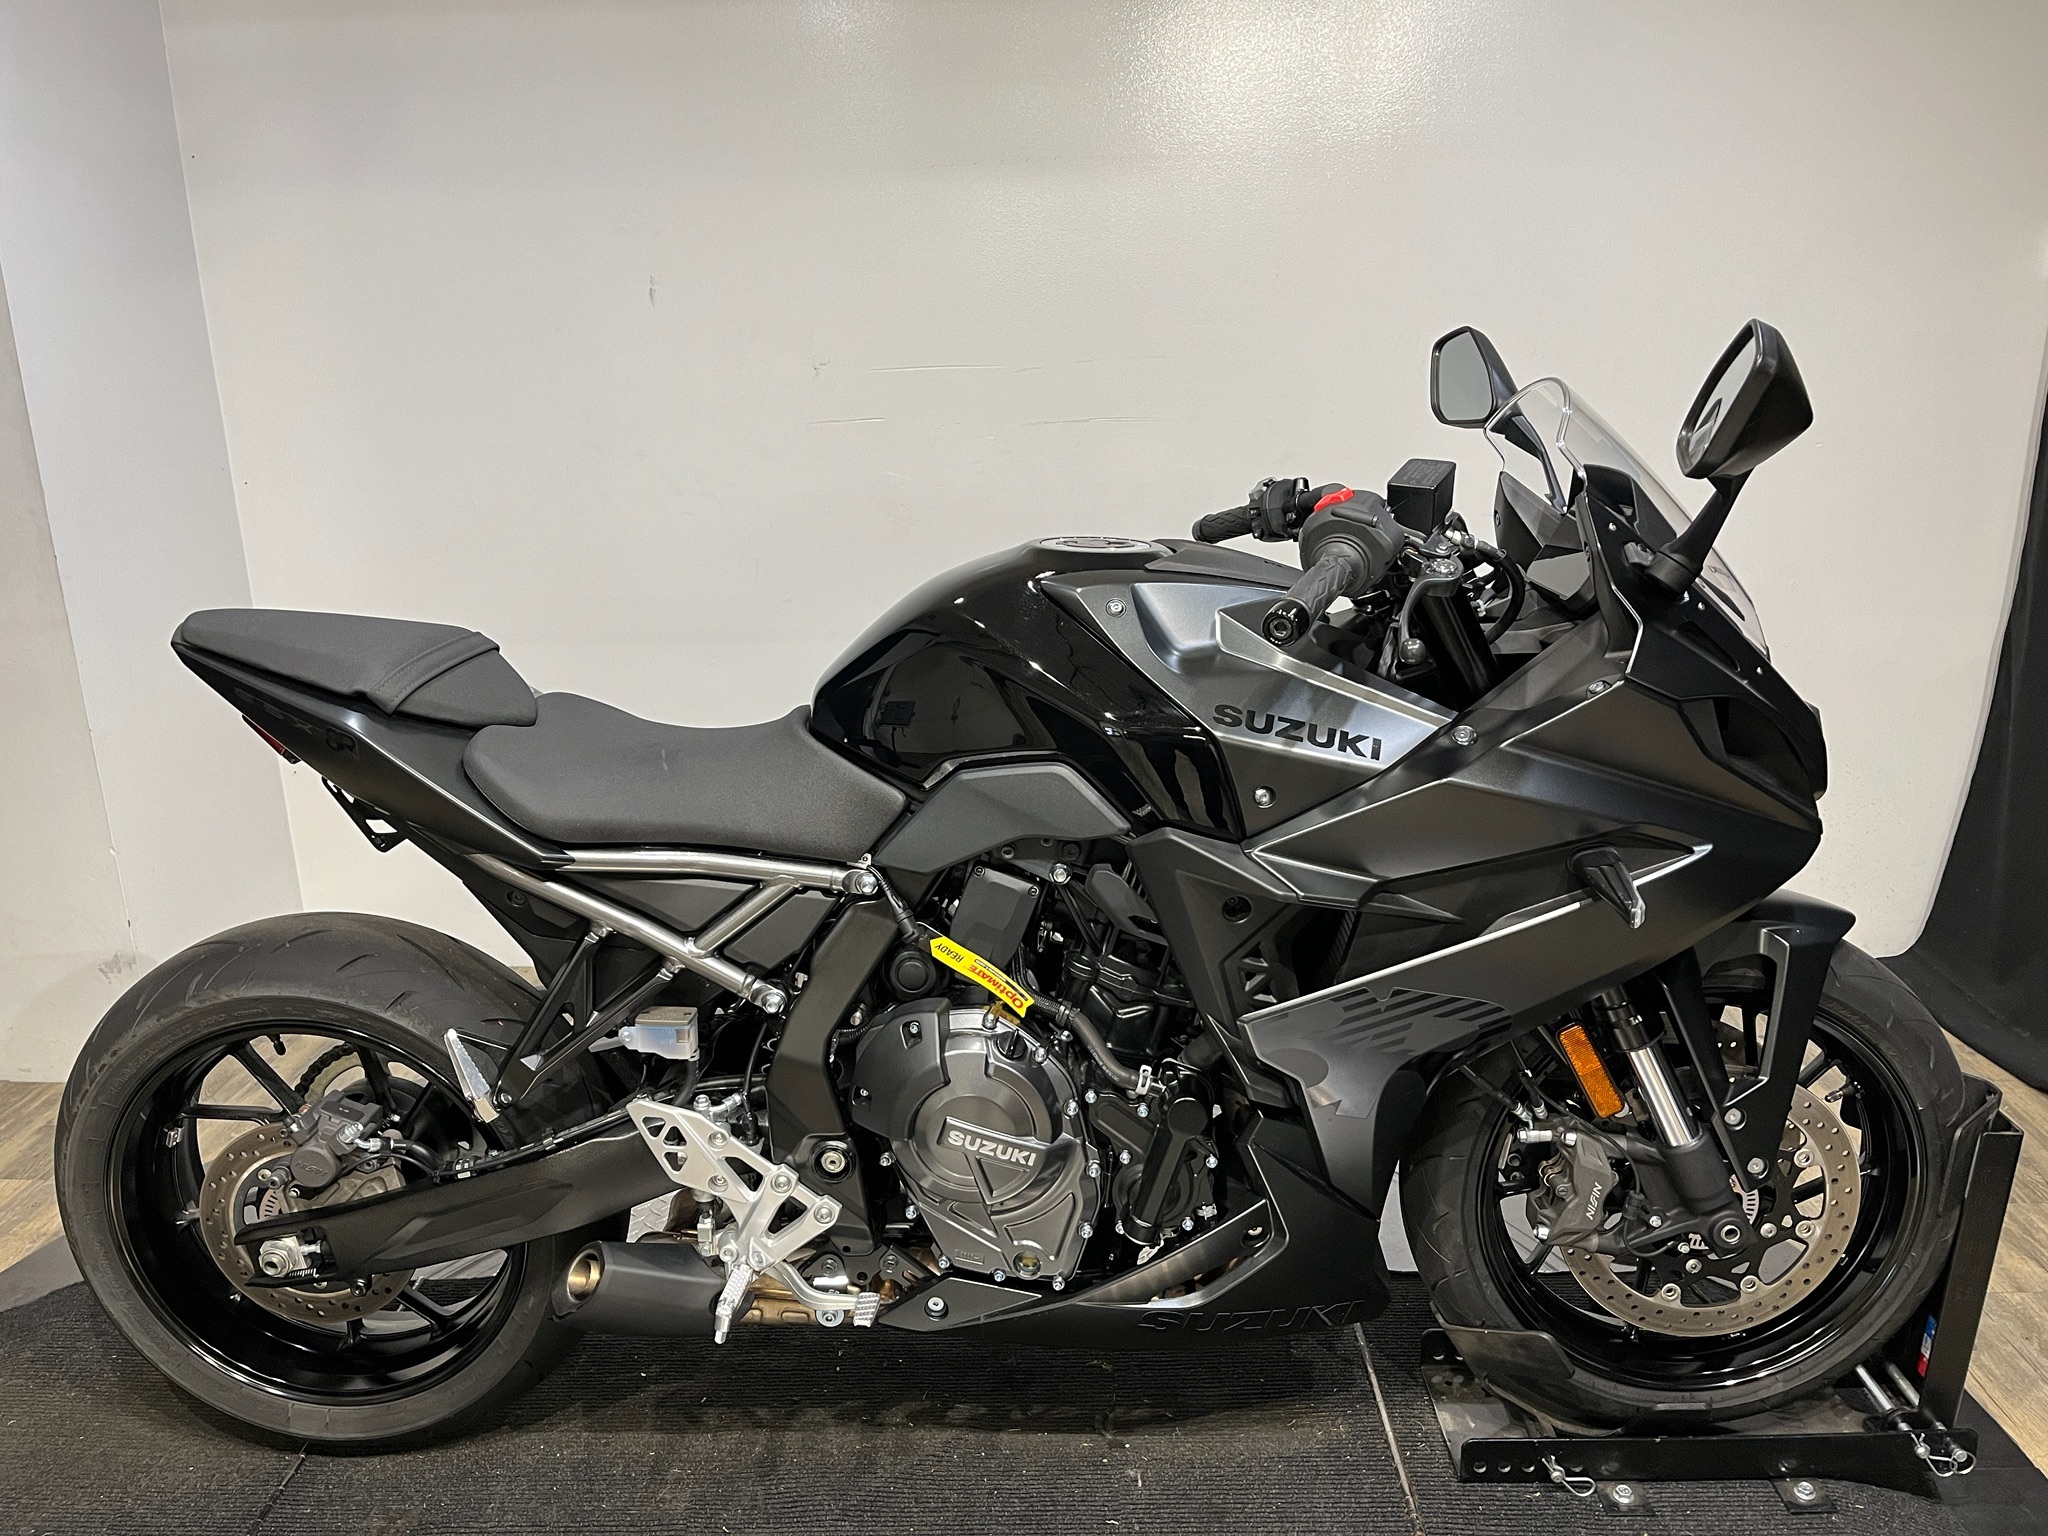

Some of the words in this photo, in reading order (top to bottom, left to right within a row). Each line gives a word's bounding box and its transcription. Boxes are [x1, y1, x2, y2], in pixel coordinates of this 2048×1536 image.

[1212, 704, 1383, 761] SUZUKI
[935, 943, 964, 963] READY
[947, 1130, 1037, 1167] SUZUKI
[1585, 1181, 1603, 1221] NISSIN
[1138, 1299, 1366, 1334] SUZUKI
